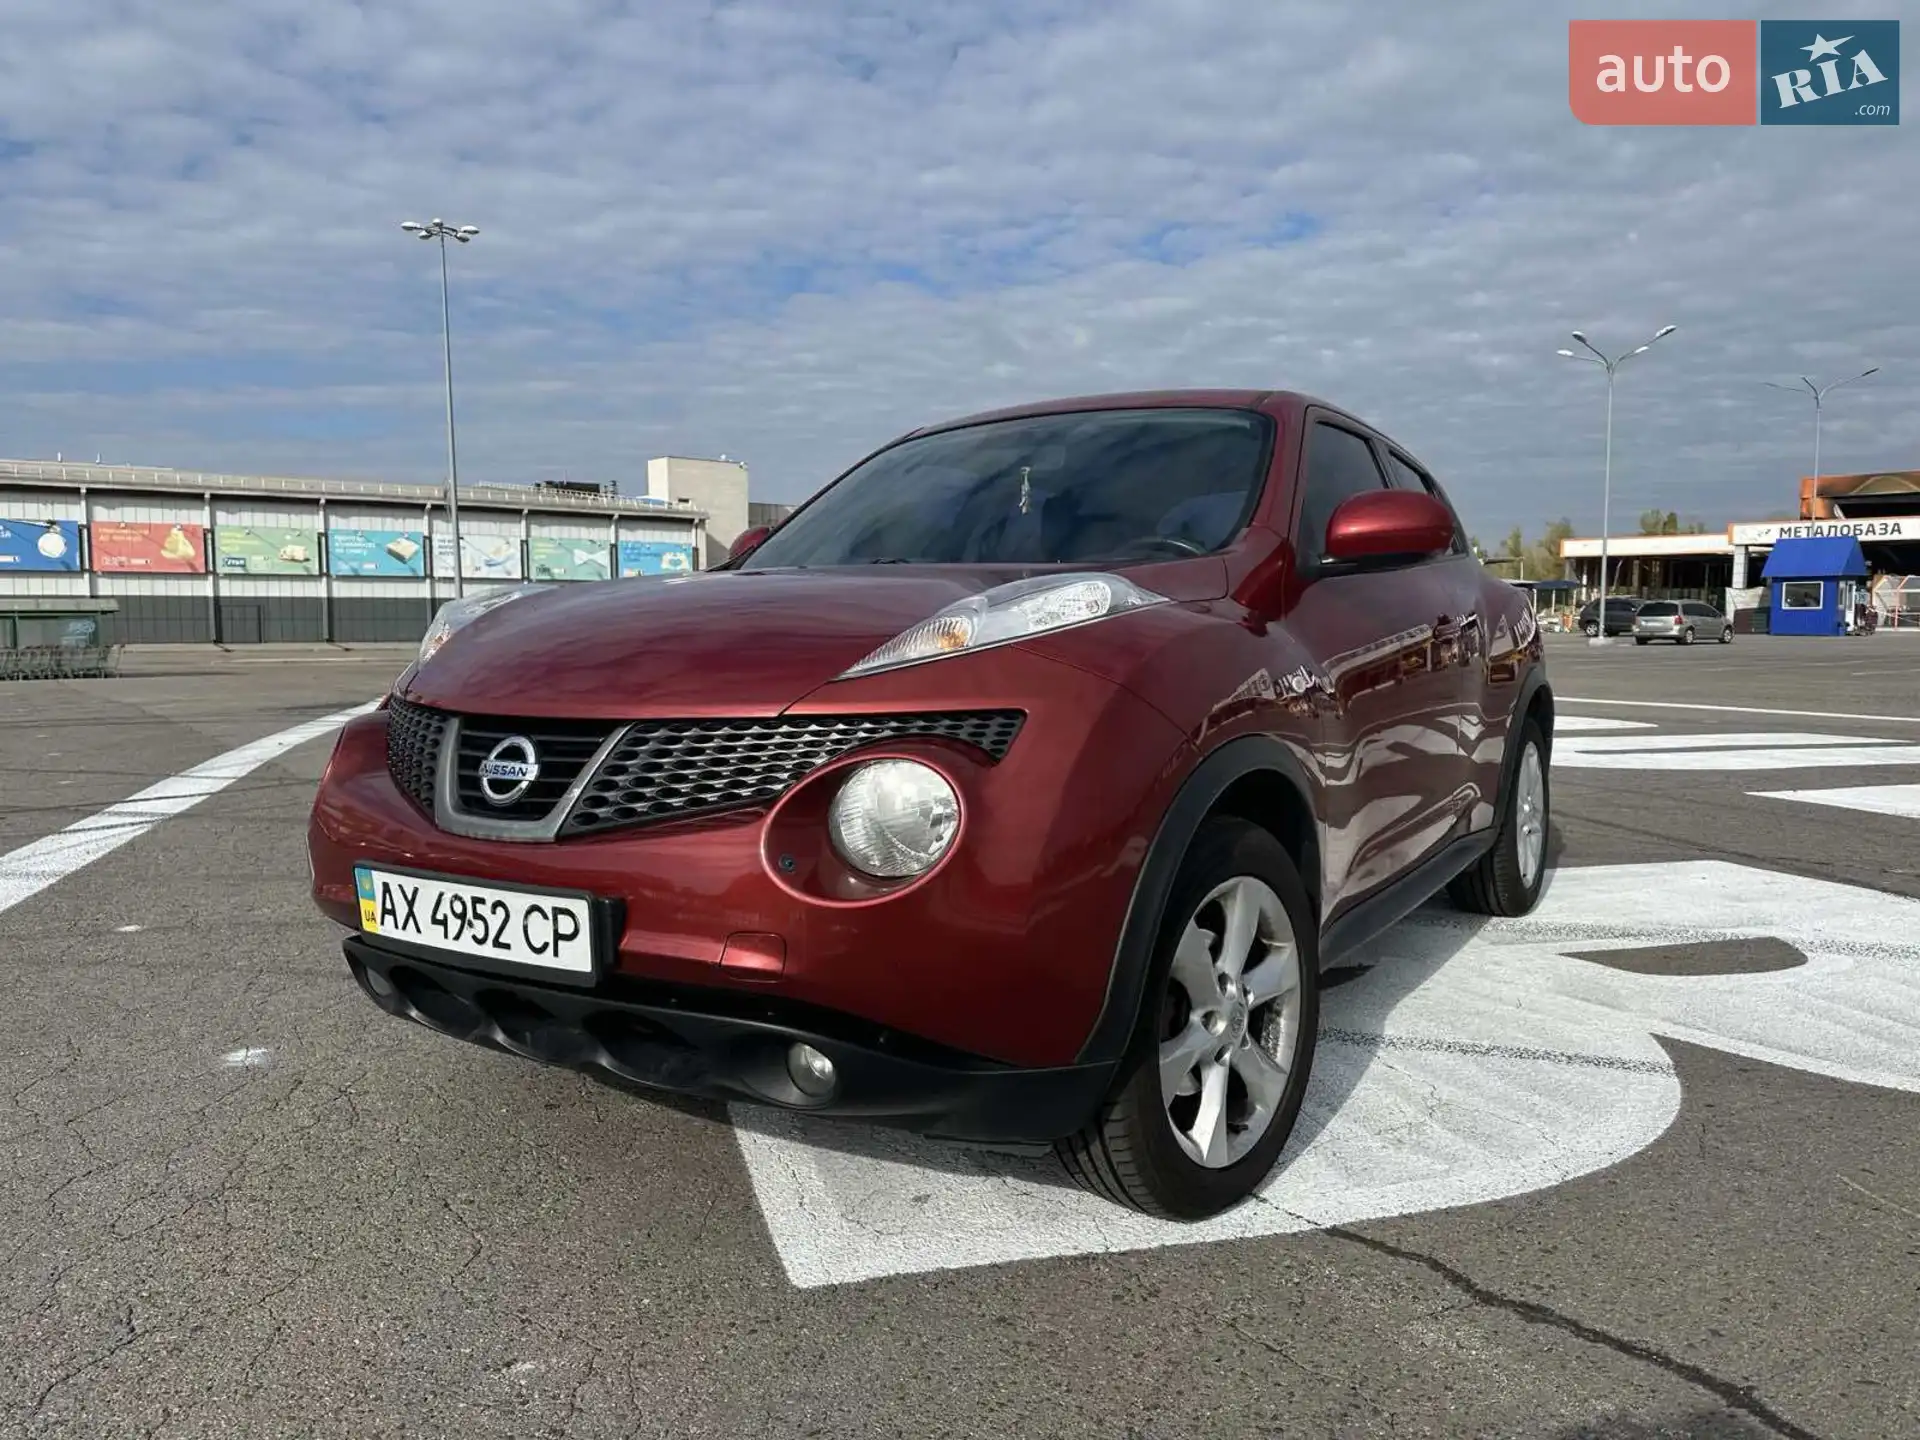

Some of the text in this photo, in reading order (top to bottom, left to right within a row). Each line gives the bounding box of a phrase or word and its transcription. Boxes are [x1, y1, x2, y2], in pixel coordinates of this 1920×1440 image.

[1778, 522, 1902, 538] МЕТАЛОБАЗА
[482, 762, 529, 778] NISSAN
[364, 909, 377, 924] UA
[380, 881, 581, 958] AX 4952 CP
